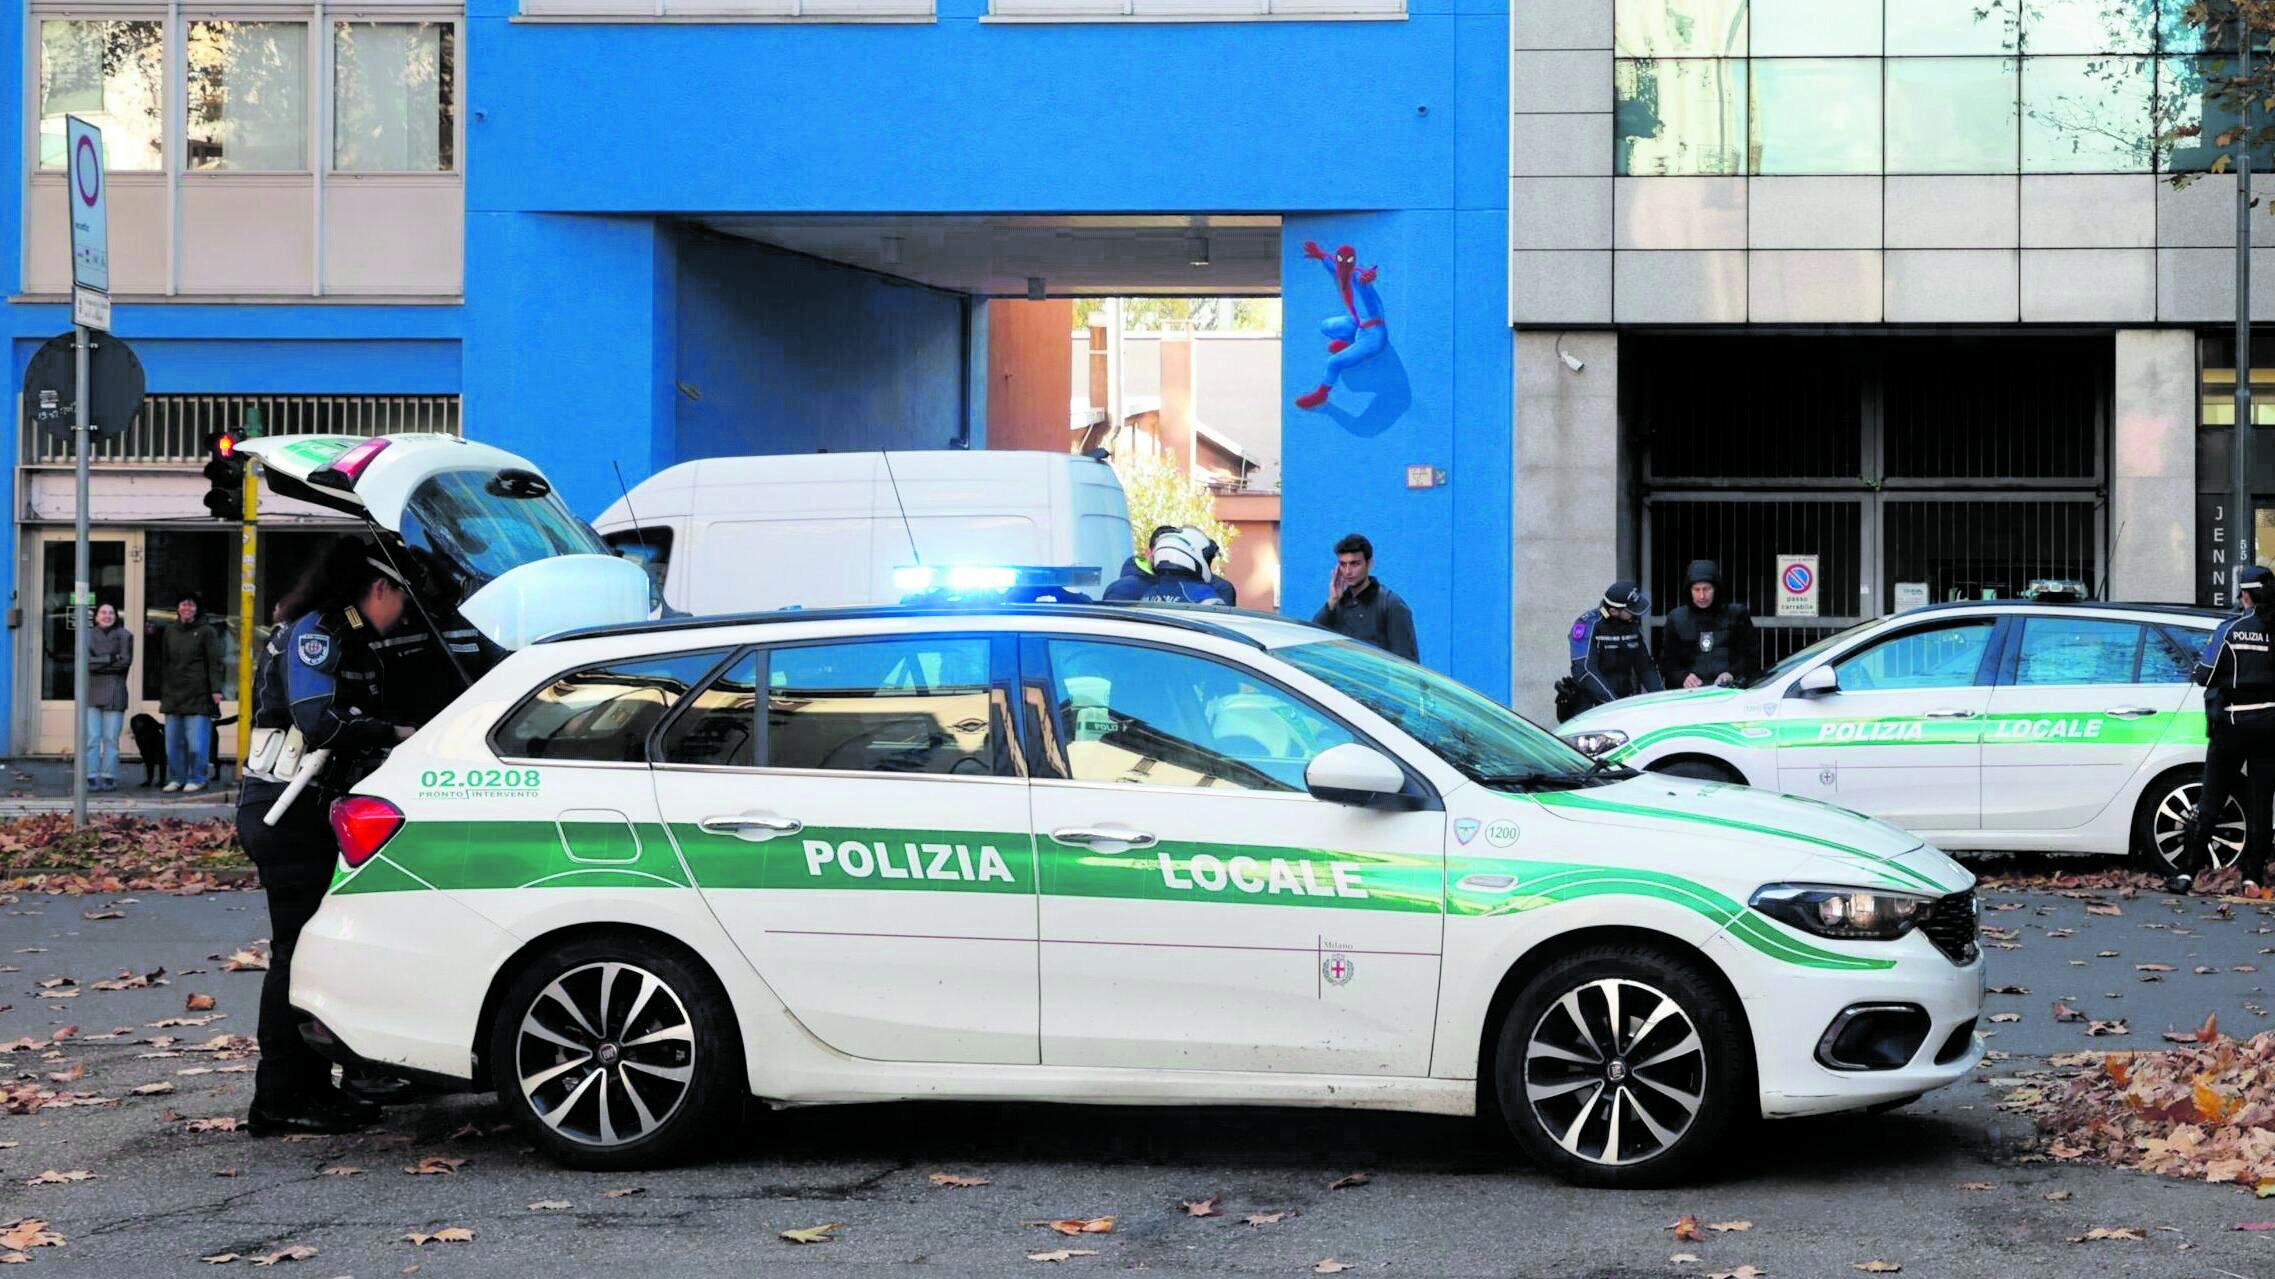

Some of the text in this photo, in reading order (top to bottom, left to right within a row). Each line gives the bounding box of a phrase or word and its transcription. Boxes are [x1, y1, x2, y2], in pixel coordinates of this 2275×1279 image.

[2213, 506, 2225, 606] JENNE
[2233, 631, 2264, 642] POLIZIA
[1818, 719, 2103, 741] POLIZIA LOCALE
[421, 770, 541, 787] 02.0208
[1489, 827, 1517, 839] 1200
[802, 840, 1369, 899] POLIZIA LOCALE
[1324, 941, 1354, 950] Milano
